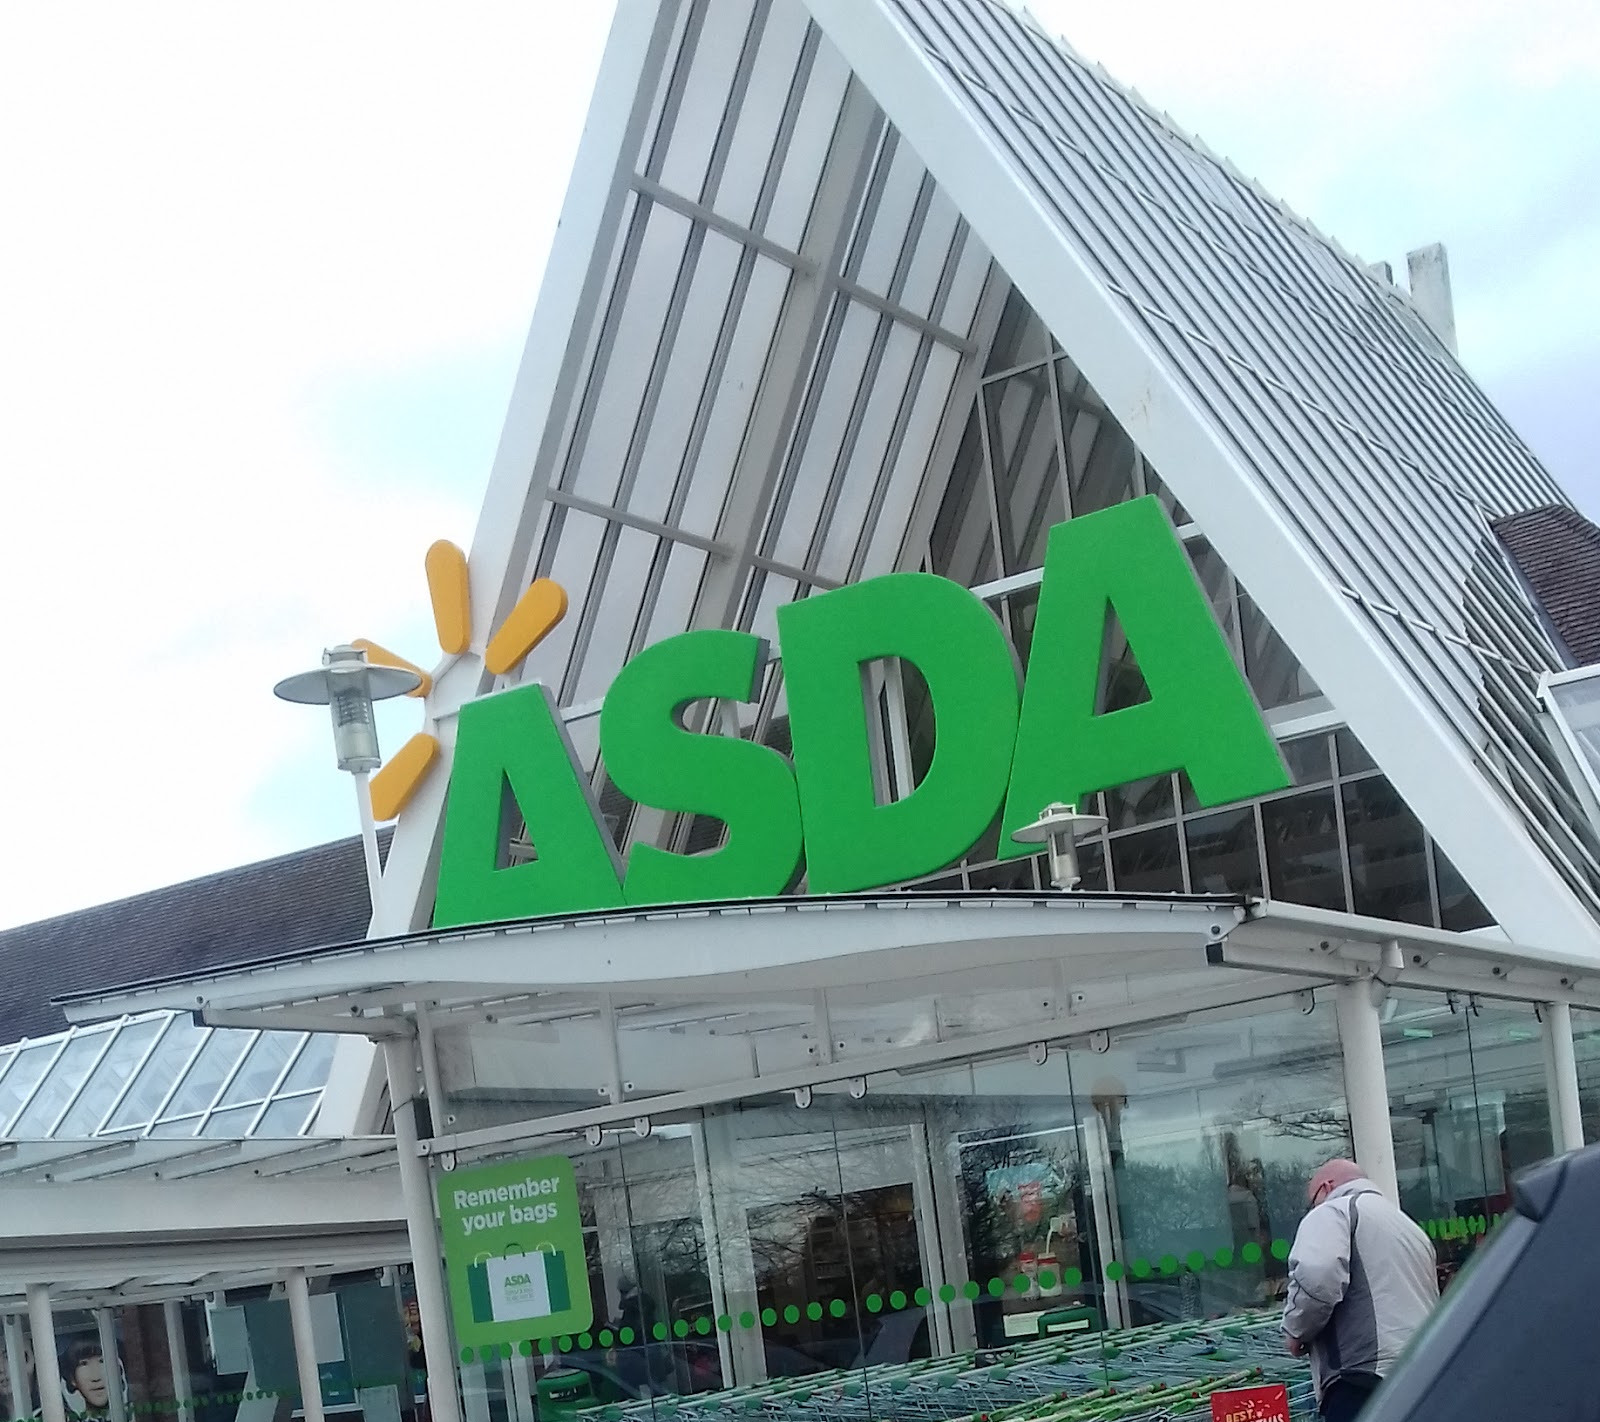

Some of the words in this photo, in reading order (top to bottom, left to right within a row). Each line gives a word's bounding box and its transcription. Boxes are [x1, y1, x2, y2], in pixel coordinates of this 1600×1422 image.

[433, 495, 1293, 929] ASDA
[453, 1177, 560, 1209] Remember
[462, 1211, 506, 1236] your
[509, 1202, 559, 1224] bags
[504, 1273, 532, 1288] ASDA
